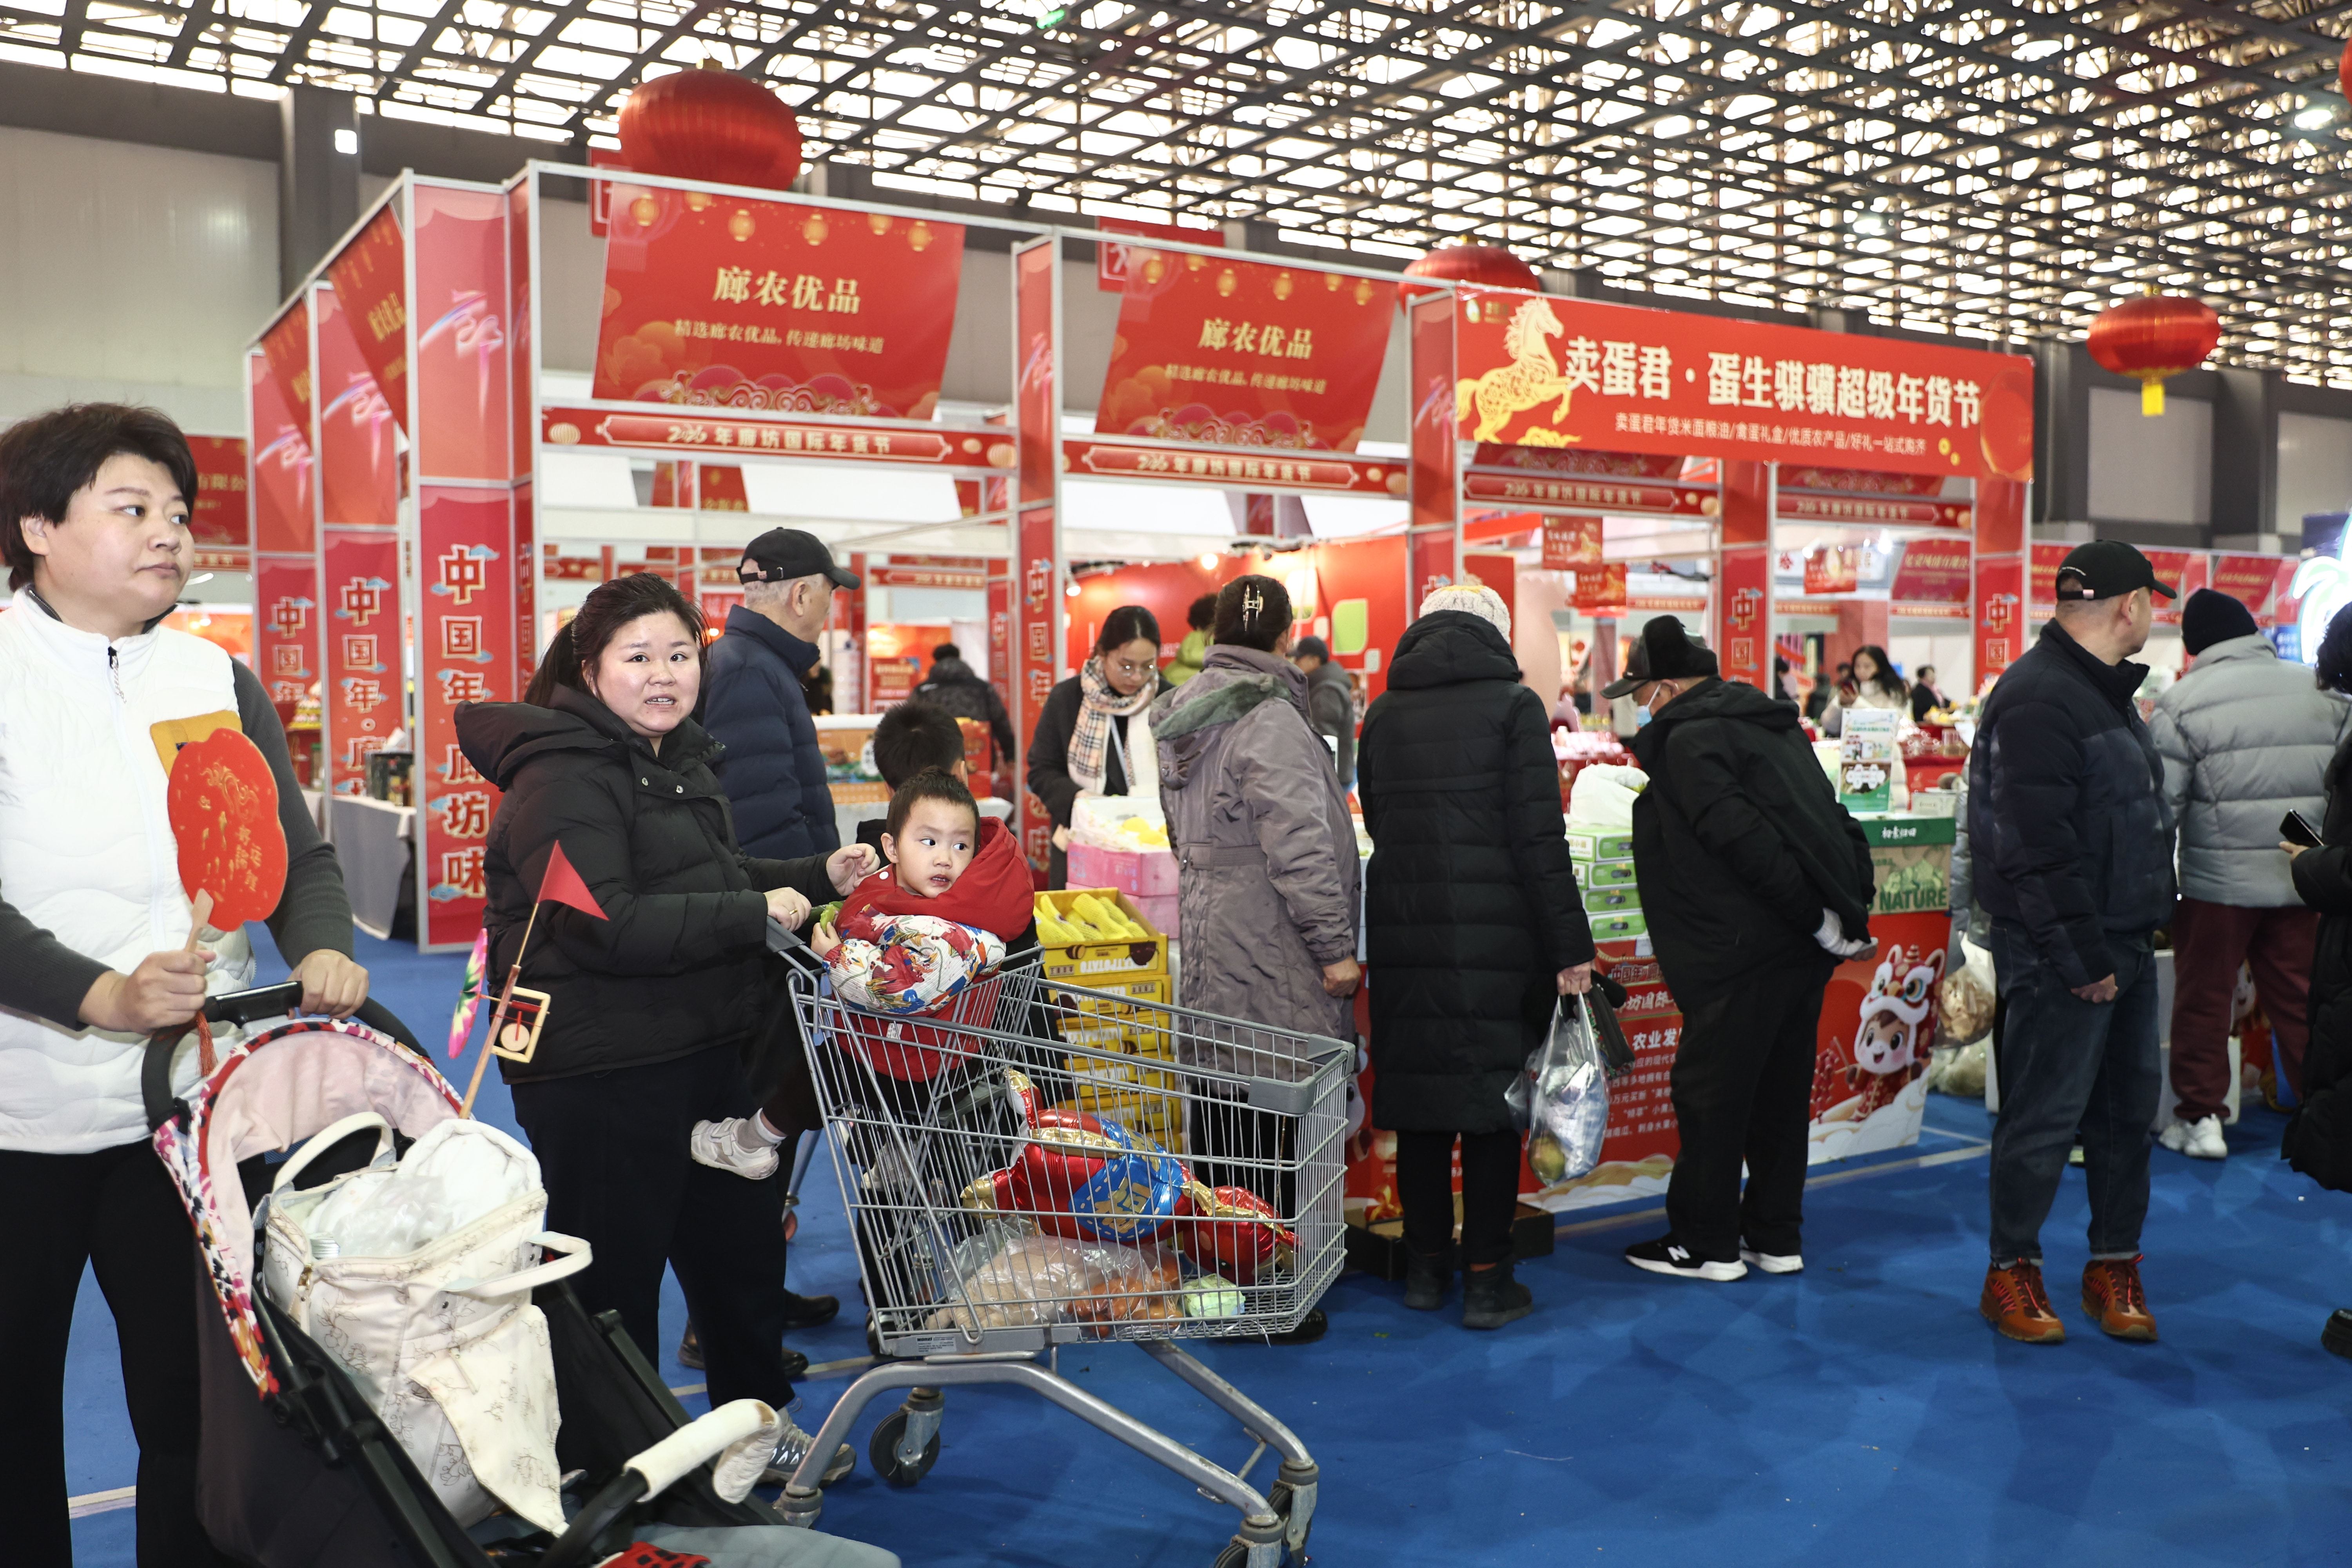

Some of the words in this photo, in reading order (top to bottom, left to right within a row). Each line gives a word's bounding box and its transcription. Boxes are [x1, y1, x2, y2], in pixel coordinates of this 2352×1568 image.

[712, 265, 862, 314] 廊农优品
[1196, 316, 1314, 360] 廊农优品
[439, 544, 491, 898] 中国年廊坊味
[1879, 887, 1947, 911] NATURE
[1632, 1027, 1682, 1051] 农业发
